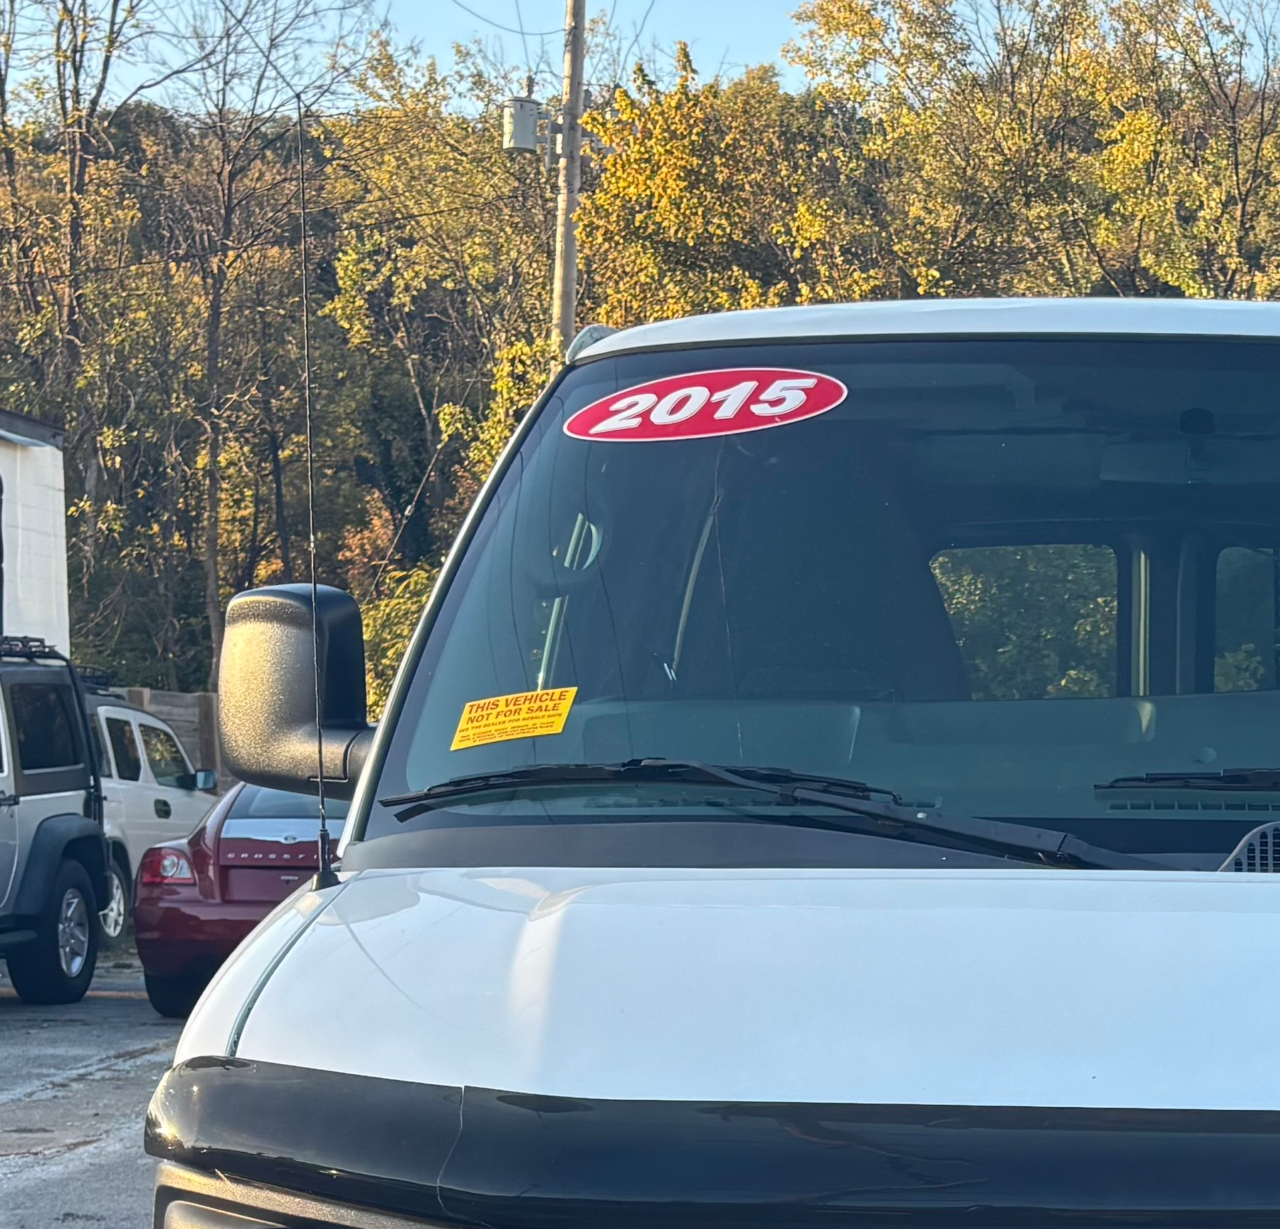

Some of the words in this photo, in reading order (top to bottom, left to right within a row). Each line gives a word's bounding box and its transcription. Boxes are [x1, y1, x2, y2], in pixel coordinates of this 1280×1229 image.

[588, 378, 818, 435] 2015
[466, 712, 493, 725] NOT
[495, 707, 522, 719] FOR
[525, 702, 561, 715] SALE
[467, 699, 500, 715] THIS
[504, 690, 569, 708] VEHICLE
[226, 851, 334, 861] CROSSFI
